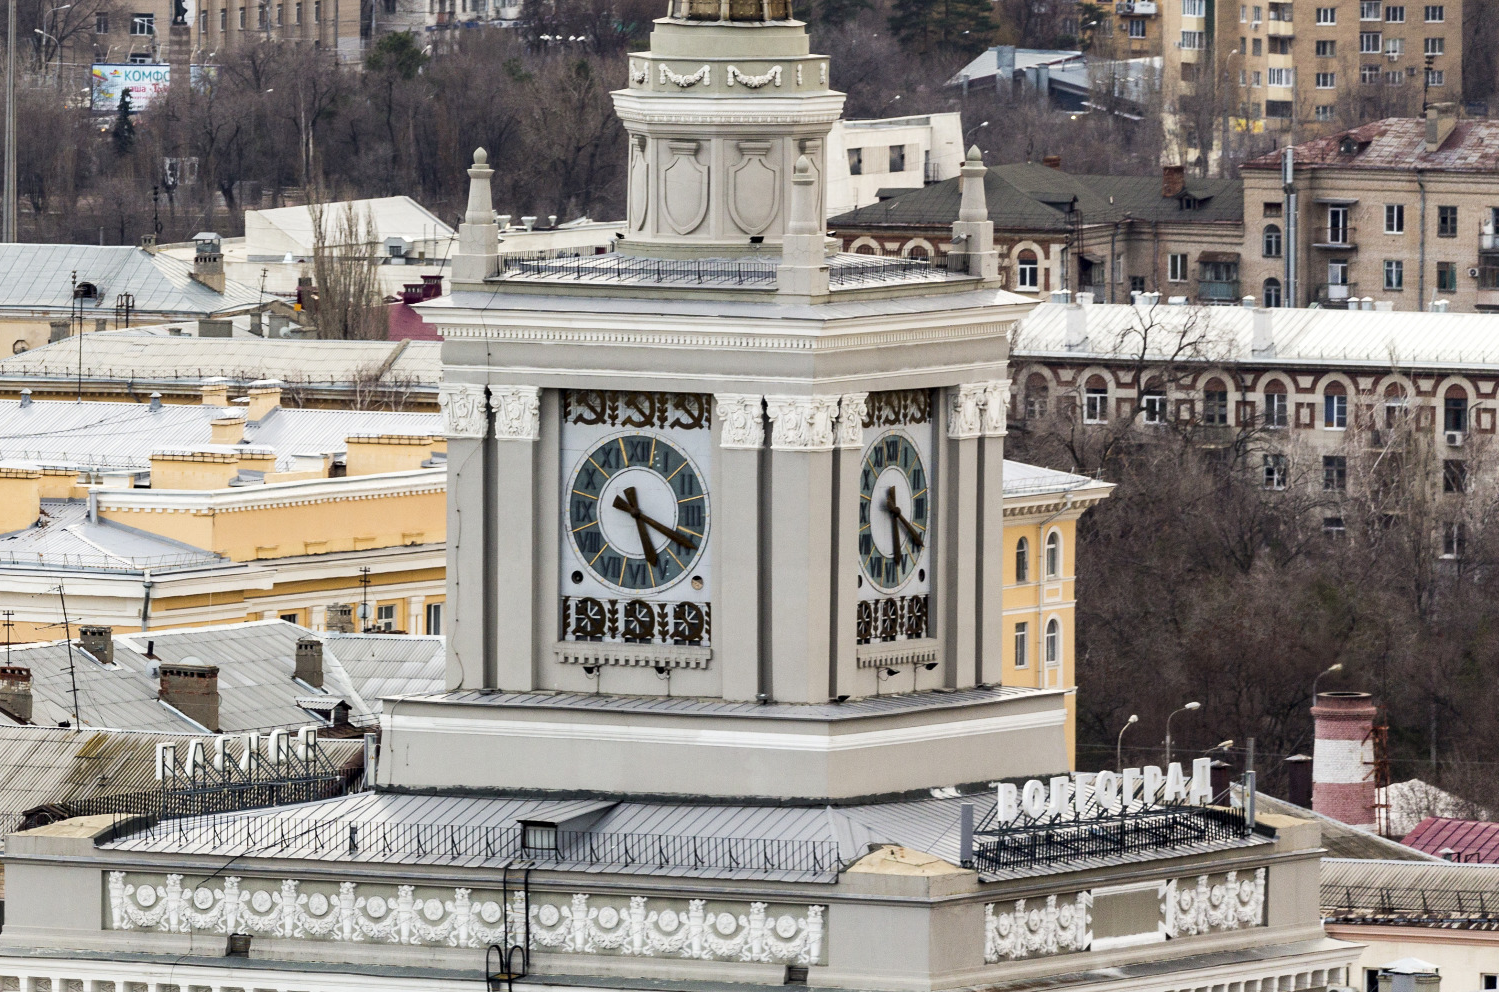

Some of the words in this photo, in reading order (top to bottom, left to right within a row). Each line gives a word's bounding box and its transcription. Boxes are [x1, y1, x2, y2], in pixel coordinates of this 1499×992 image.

[602, 447, 619, 469] XI
[630, 441, 649, 462] XII
[874, 446, 883, 467] XI
[886, 440, 897, 461] XII
[585, 469, 596, 489] X
[681, 474, 692, 495] II
[863, 470, 870, 490] X
[914, 469, 920, 489] II
[576, 501, 592, 522] IX
[686, 506, 700, 526] III
[860, 502, 867, 523] X
[916, 498, 924, 519] III
[579, 532, 600, 553] VIII
[601, 556, 620, 578] VII
[627, 564, 645, 585] VI
[656, 559, 668, 580] V
[870, 557, 882, 577] VII
[885, 563, 895, 582] VI
[901, 554, 907, 574] V
[997, 757, 1213, 823] ВОЛГОГРАД
